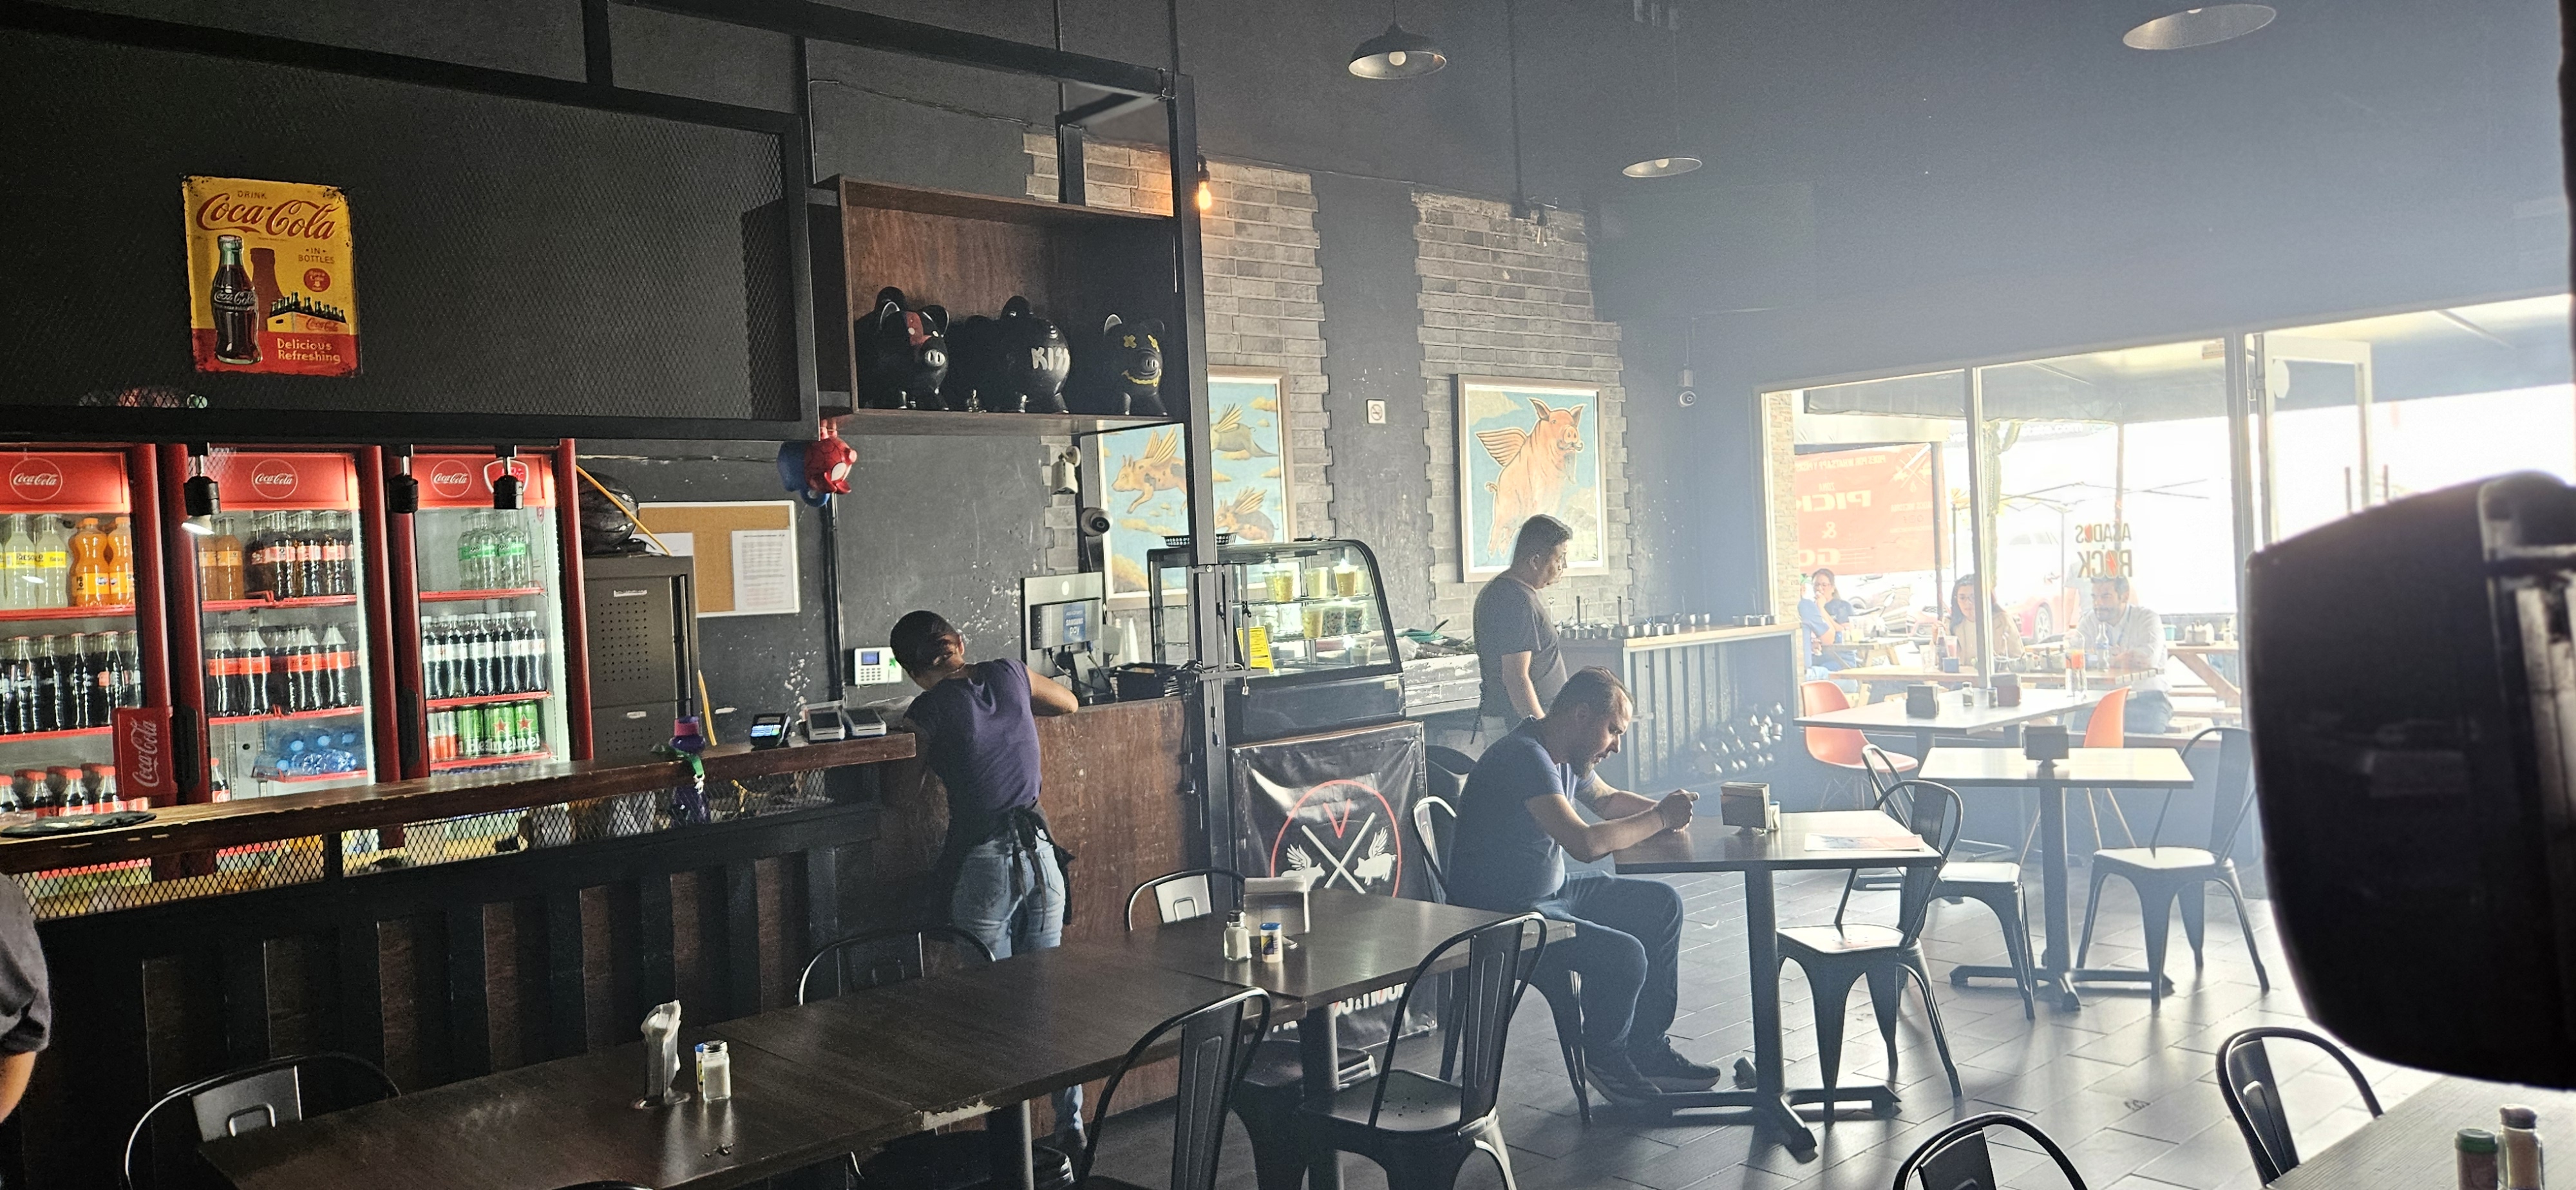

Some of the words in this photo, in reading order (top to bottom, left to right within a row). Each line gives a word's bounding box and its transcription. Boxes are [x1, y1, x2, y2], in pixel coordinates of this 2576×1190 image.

[237, 191, 267, 200] DRINK
[298, 254, 335, 264] BOTTLES
[277, 337, 332, 350] Delicious
[278, 349, 341, 364] Refreshing
[1031, 346, 1070, 371] KISS
[1065, 618, 1084, 627] SAMSUNG
[1069, 626, 1081, 637] pay
